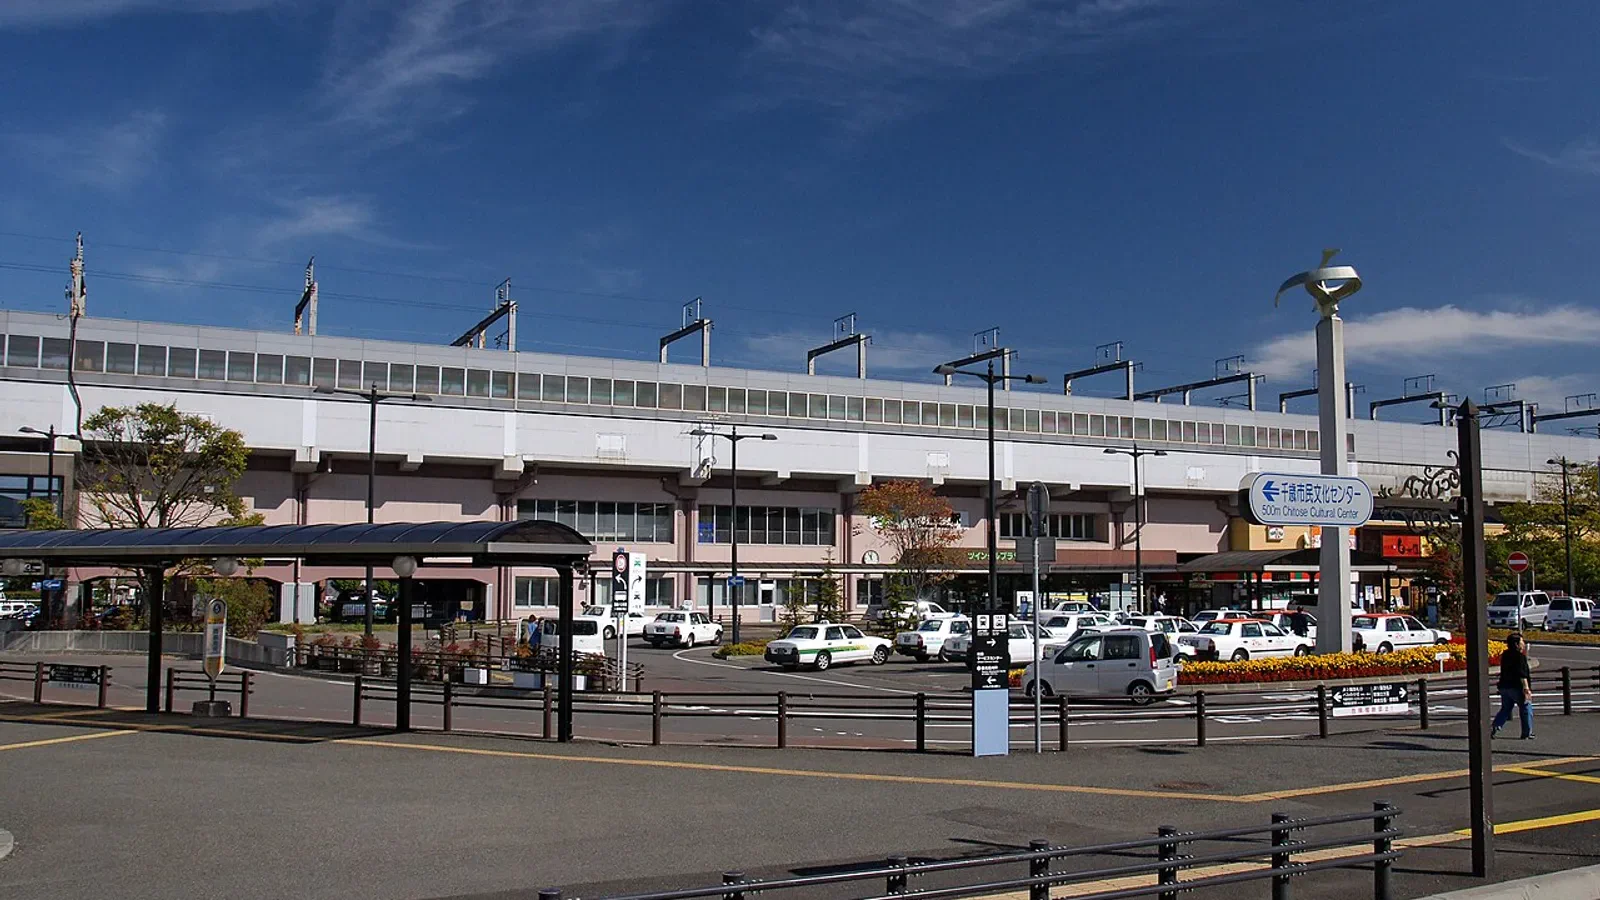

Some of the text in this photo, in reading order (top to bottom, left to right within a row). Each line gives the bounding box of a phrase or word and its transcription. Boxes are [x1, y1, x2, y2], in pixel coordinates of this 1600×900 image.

[1281, 482, 1361, 504] 千歳市民文化センター
[1262, 505, 1358, 519] 500m Chitose Cultural Center
